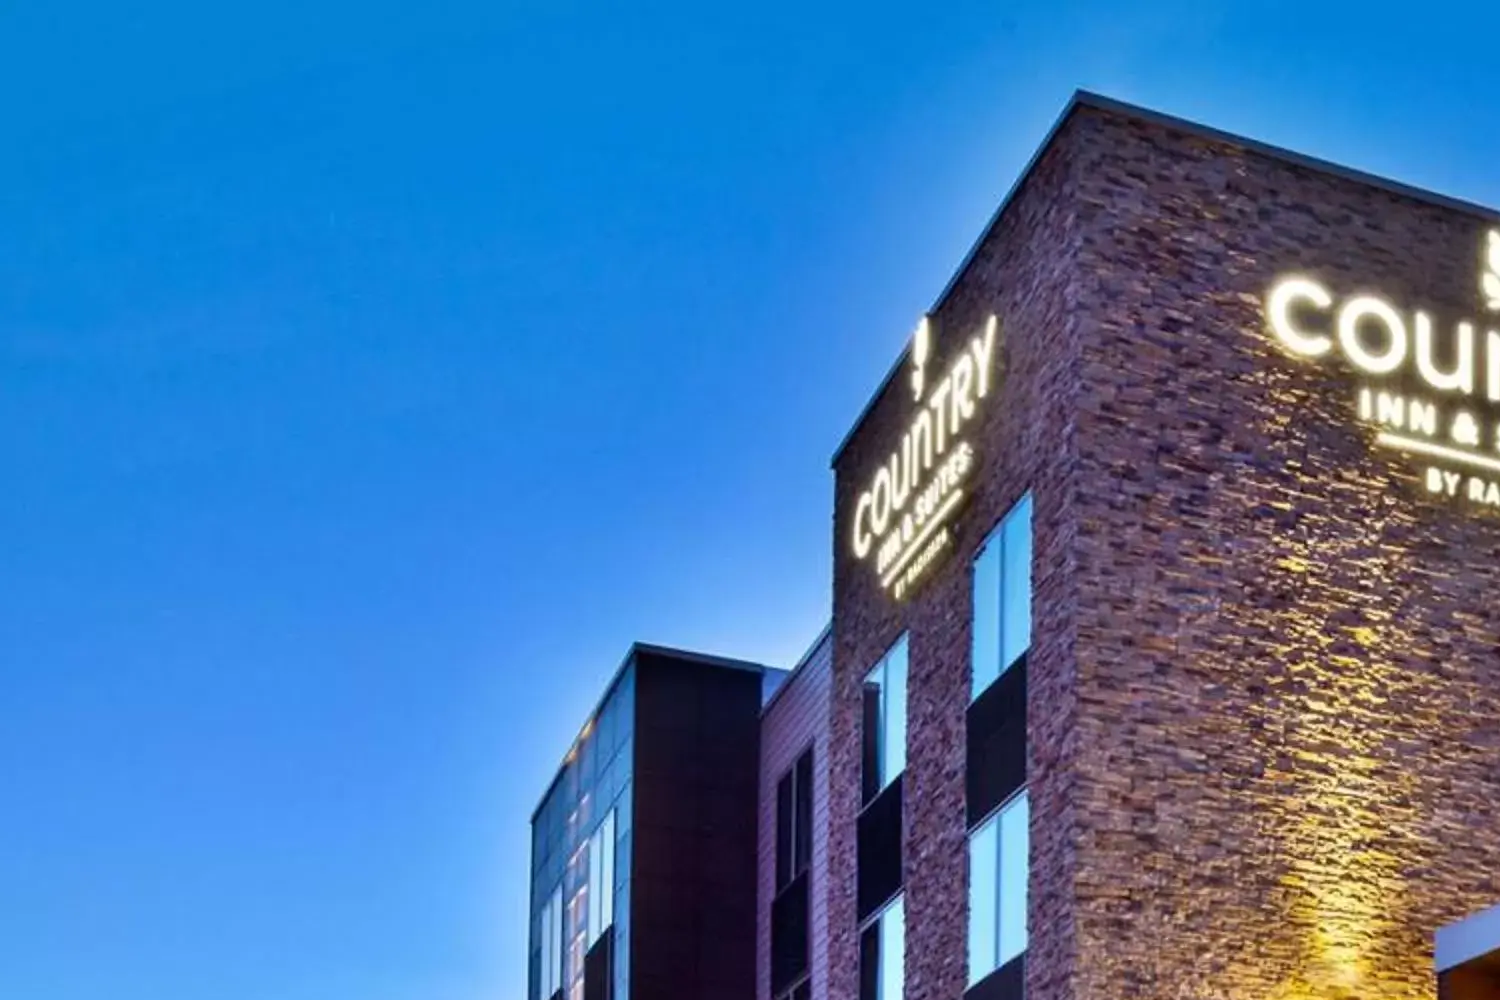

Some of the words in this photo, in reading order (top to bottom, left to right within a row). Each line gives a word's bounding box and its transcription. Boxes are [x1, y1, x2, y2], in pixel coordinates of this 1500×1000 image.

[853, 313, 997, 560] COUNTRY
[1358, 388, 1437, 436] INN
[1451, 411, 1480, 447] &
[1426, 467, 1460, 497] BY
